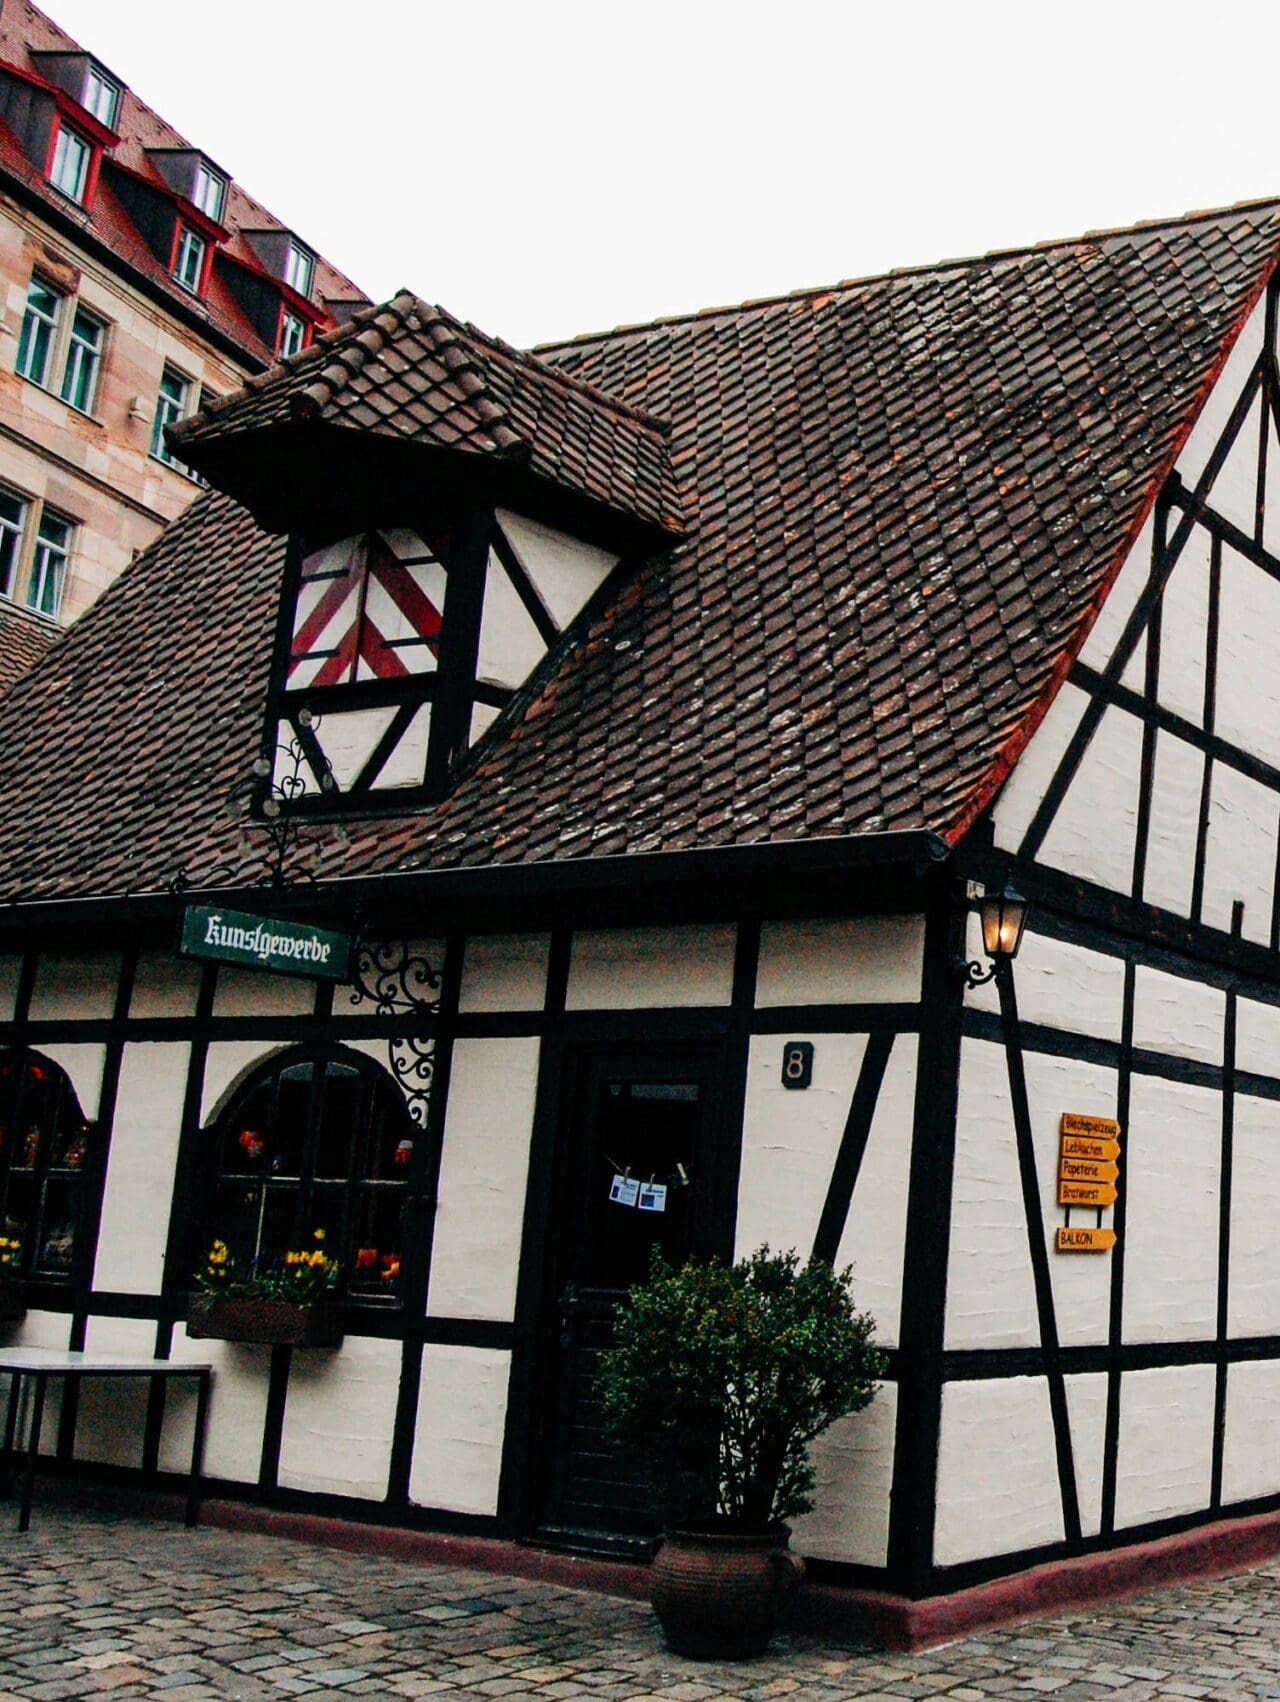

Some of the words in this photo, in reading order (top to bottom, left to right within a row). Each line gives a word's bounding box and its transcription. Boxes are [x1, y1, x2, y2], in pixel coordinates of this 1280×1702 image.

[205, 915, 330, 963] Kunstgewerbe
[786, 1050, 804, 1079] 8
[1066, 1117, 1116, 1138] Blechspielzeug
[1065, 1140, 1102, 1156] Lebkuchen
[1064, 1161, 1098, 1177] Papeterie
[1063, 1185, 1098, 1200] Bratwurst
[1061, 1232, 1092, 1246] BALKON
